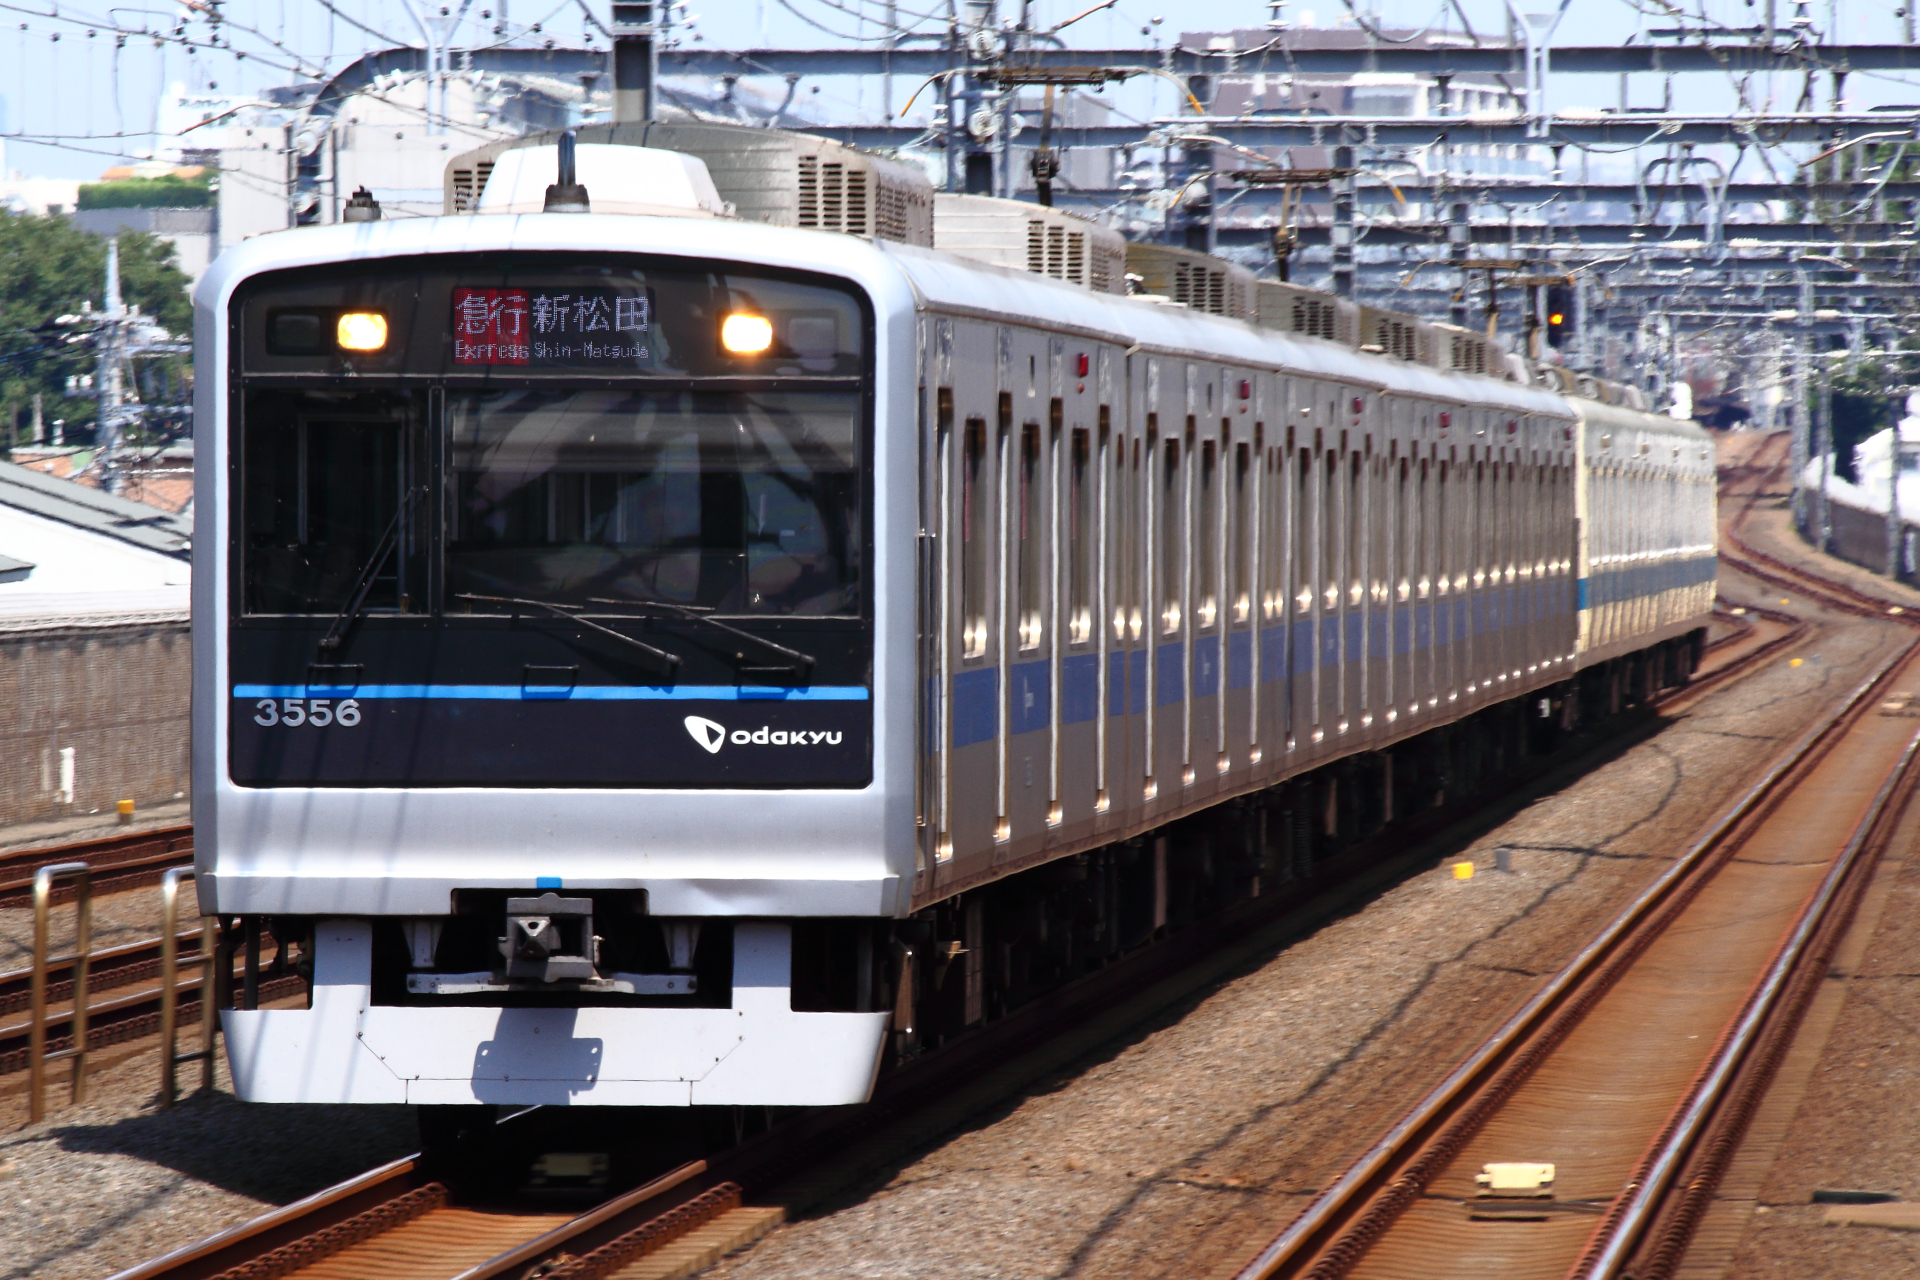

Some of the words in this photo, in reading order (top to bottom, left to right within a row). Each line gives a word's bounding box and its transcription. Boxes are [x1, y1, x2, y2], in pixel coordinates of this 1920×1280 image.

[456, 293, 528, 335] 急行
[533, 294, 649, 333] 新松田
[455, 339, 530, 359] Express
[534, 341, 649, 359] Shin-Matsuda
[254, 699, 361, 727] 3556
[730, 725, 843, 745] odakyu
